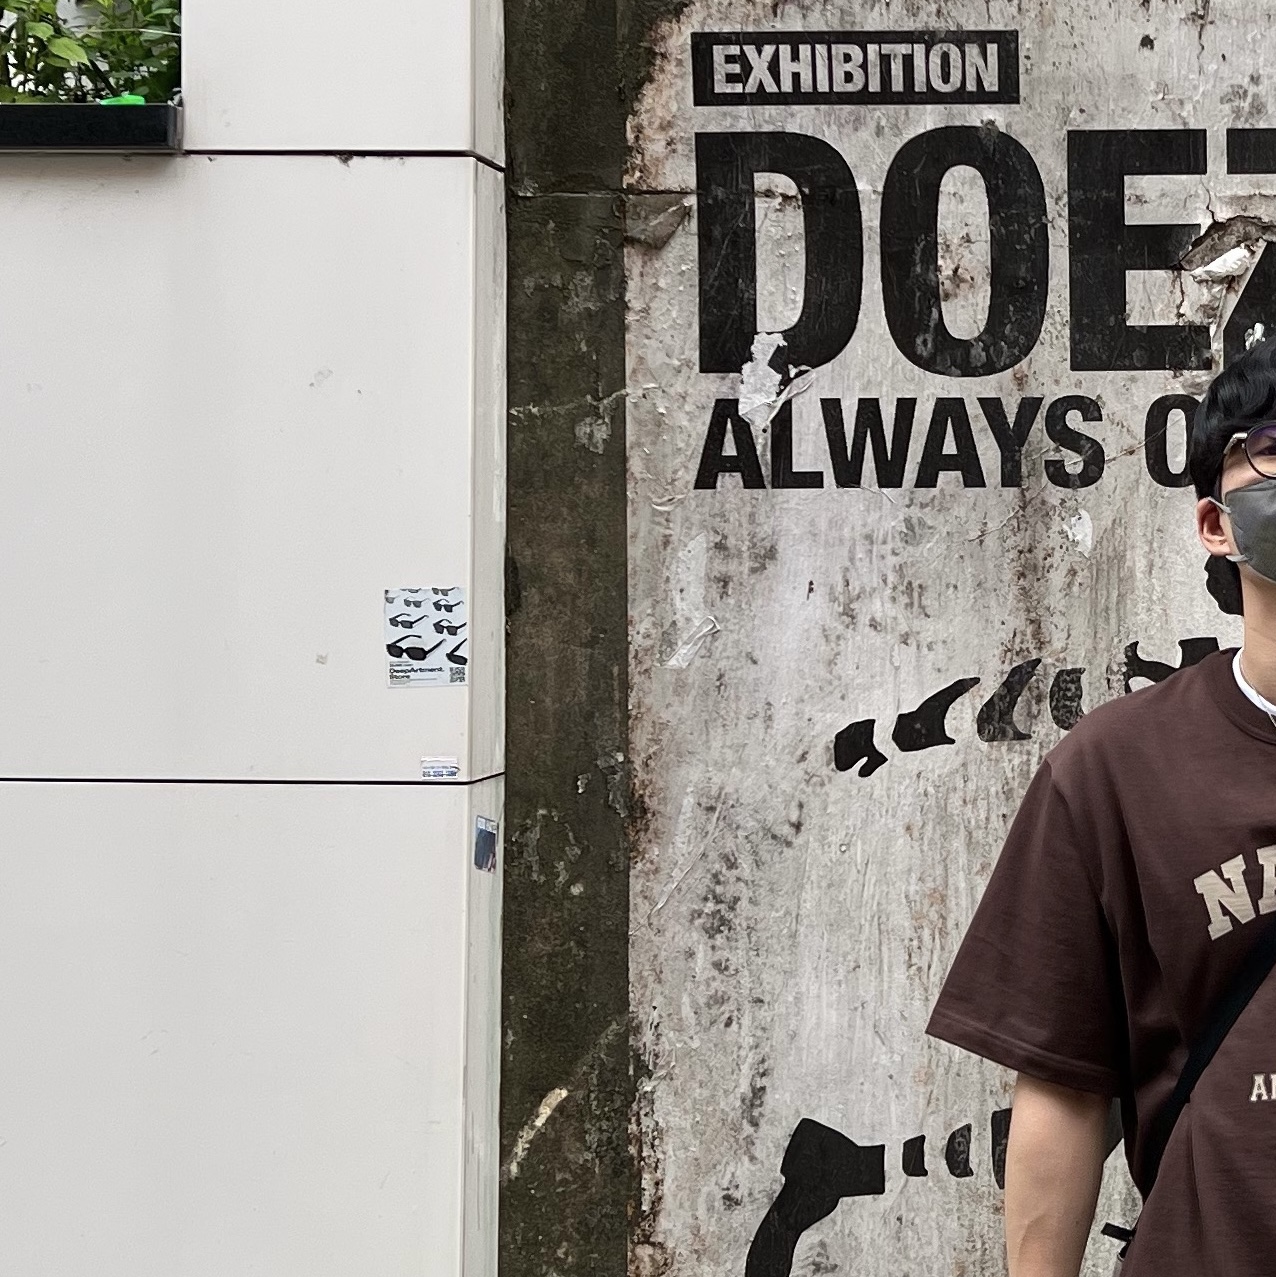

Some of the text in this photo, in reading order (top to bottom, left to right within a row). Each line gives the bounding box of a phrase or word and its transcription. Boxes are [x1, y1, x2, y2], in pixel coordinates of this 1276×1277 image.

[712, 42, 999, 94] EXHIBITION
[694, 395, 1104, 490] ALWAYS
[1145, 393, 1202, 488] O
